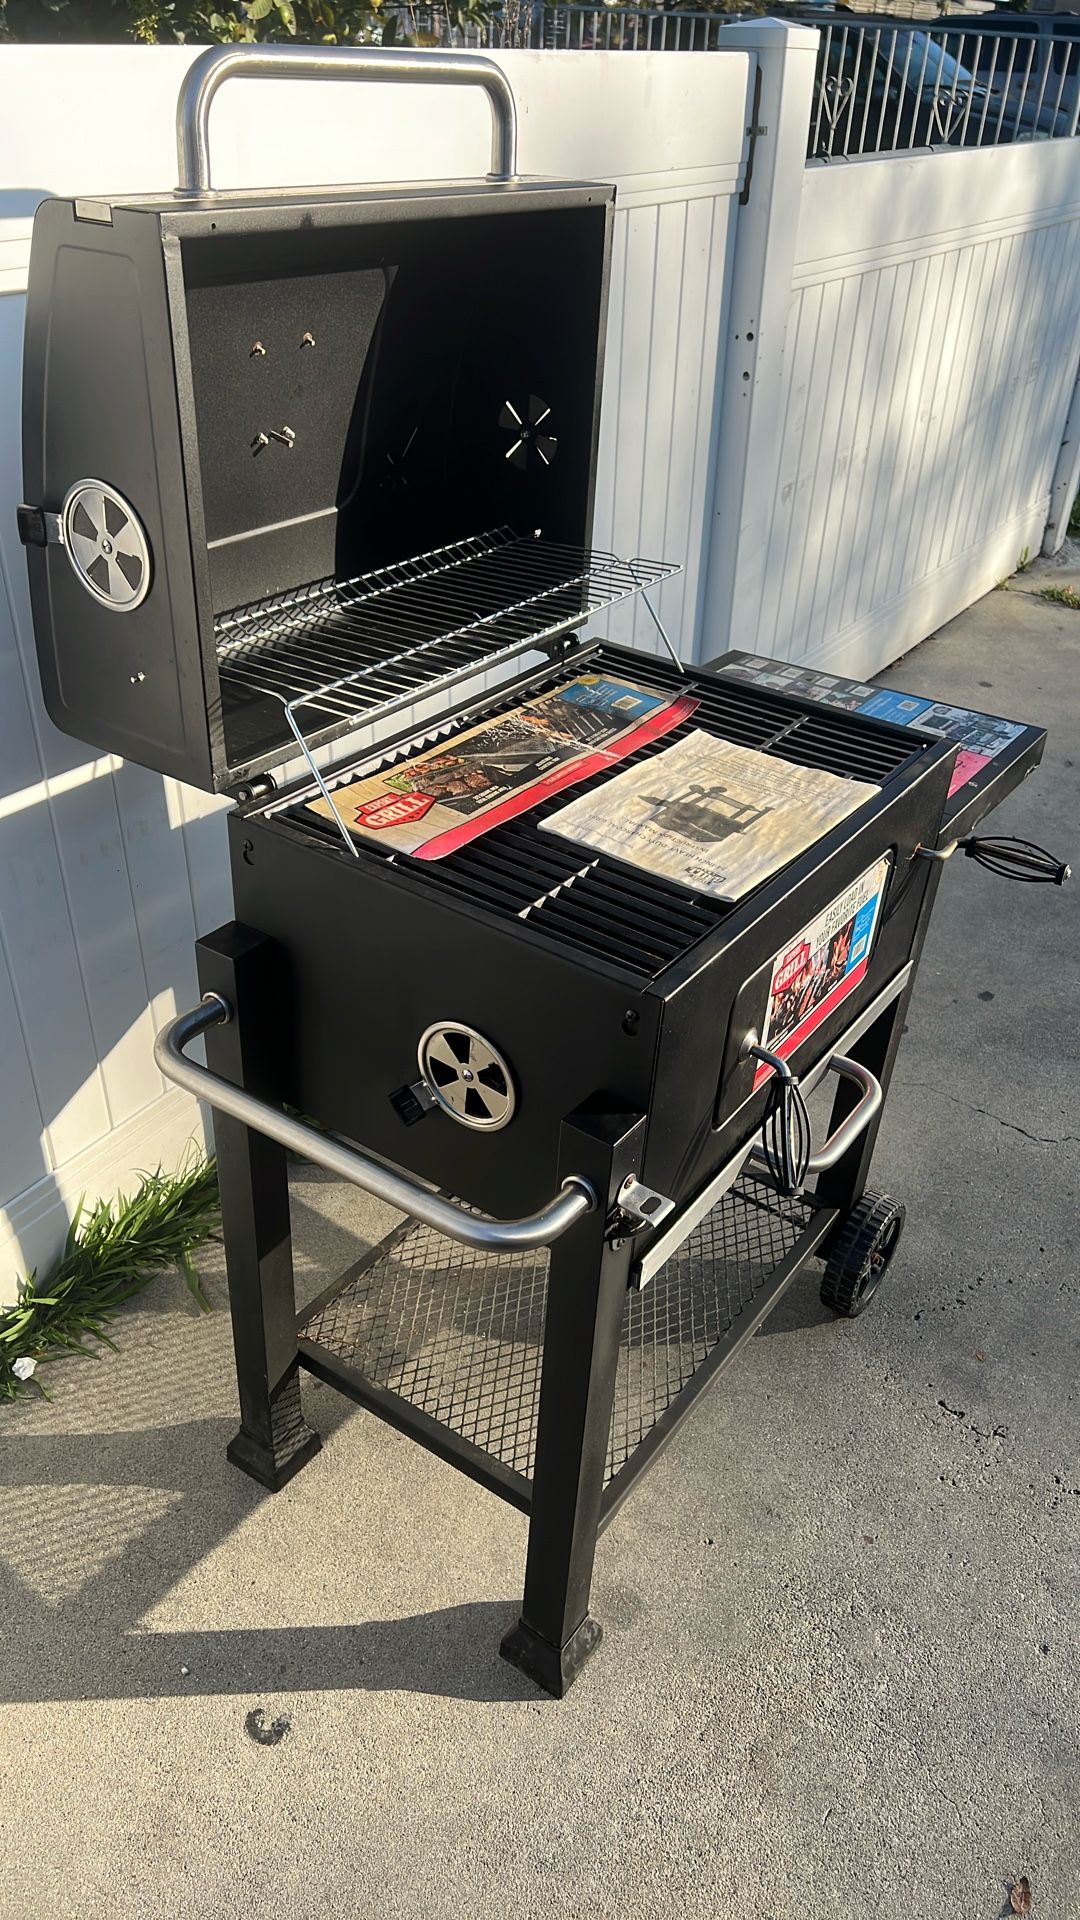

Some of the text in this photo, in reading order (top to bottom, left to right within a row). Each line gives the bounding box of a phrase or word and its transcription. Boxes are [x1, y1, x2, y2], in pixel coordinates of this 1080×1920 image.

[365, 797, 430, 826] GRILL
[825, 903, 844, 927] EASILY
[844, 887, 858, 911] LOAD
[775, 949, 806, 990] GRILL
